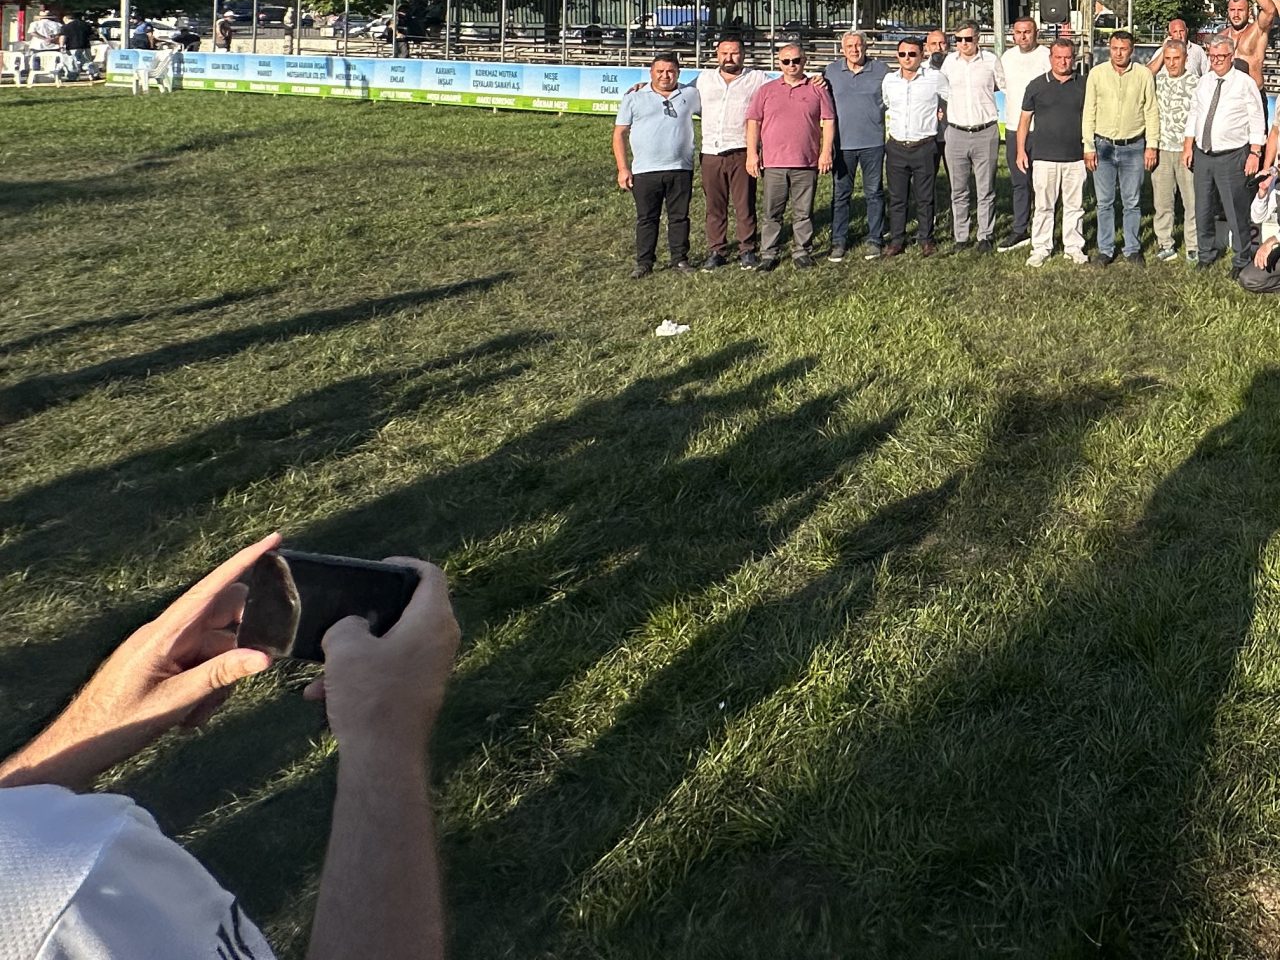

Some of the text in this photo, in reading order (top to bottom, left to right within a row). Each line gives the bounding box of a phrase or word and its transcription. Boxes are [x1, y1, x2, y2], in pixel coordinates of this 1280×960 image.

[544, 72, 559, 81] MEŞE
[602, 73, 618, 83] DİLEK
[541, 83, 560, 92] İNŞAAT
[600, 86, 619, 94] EMLAK
